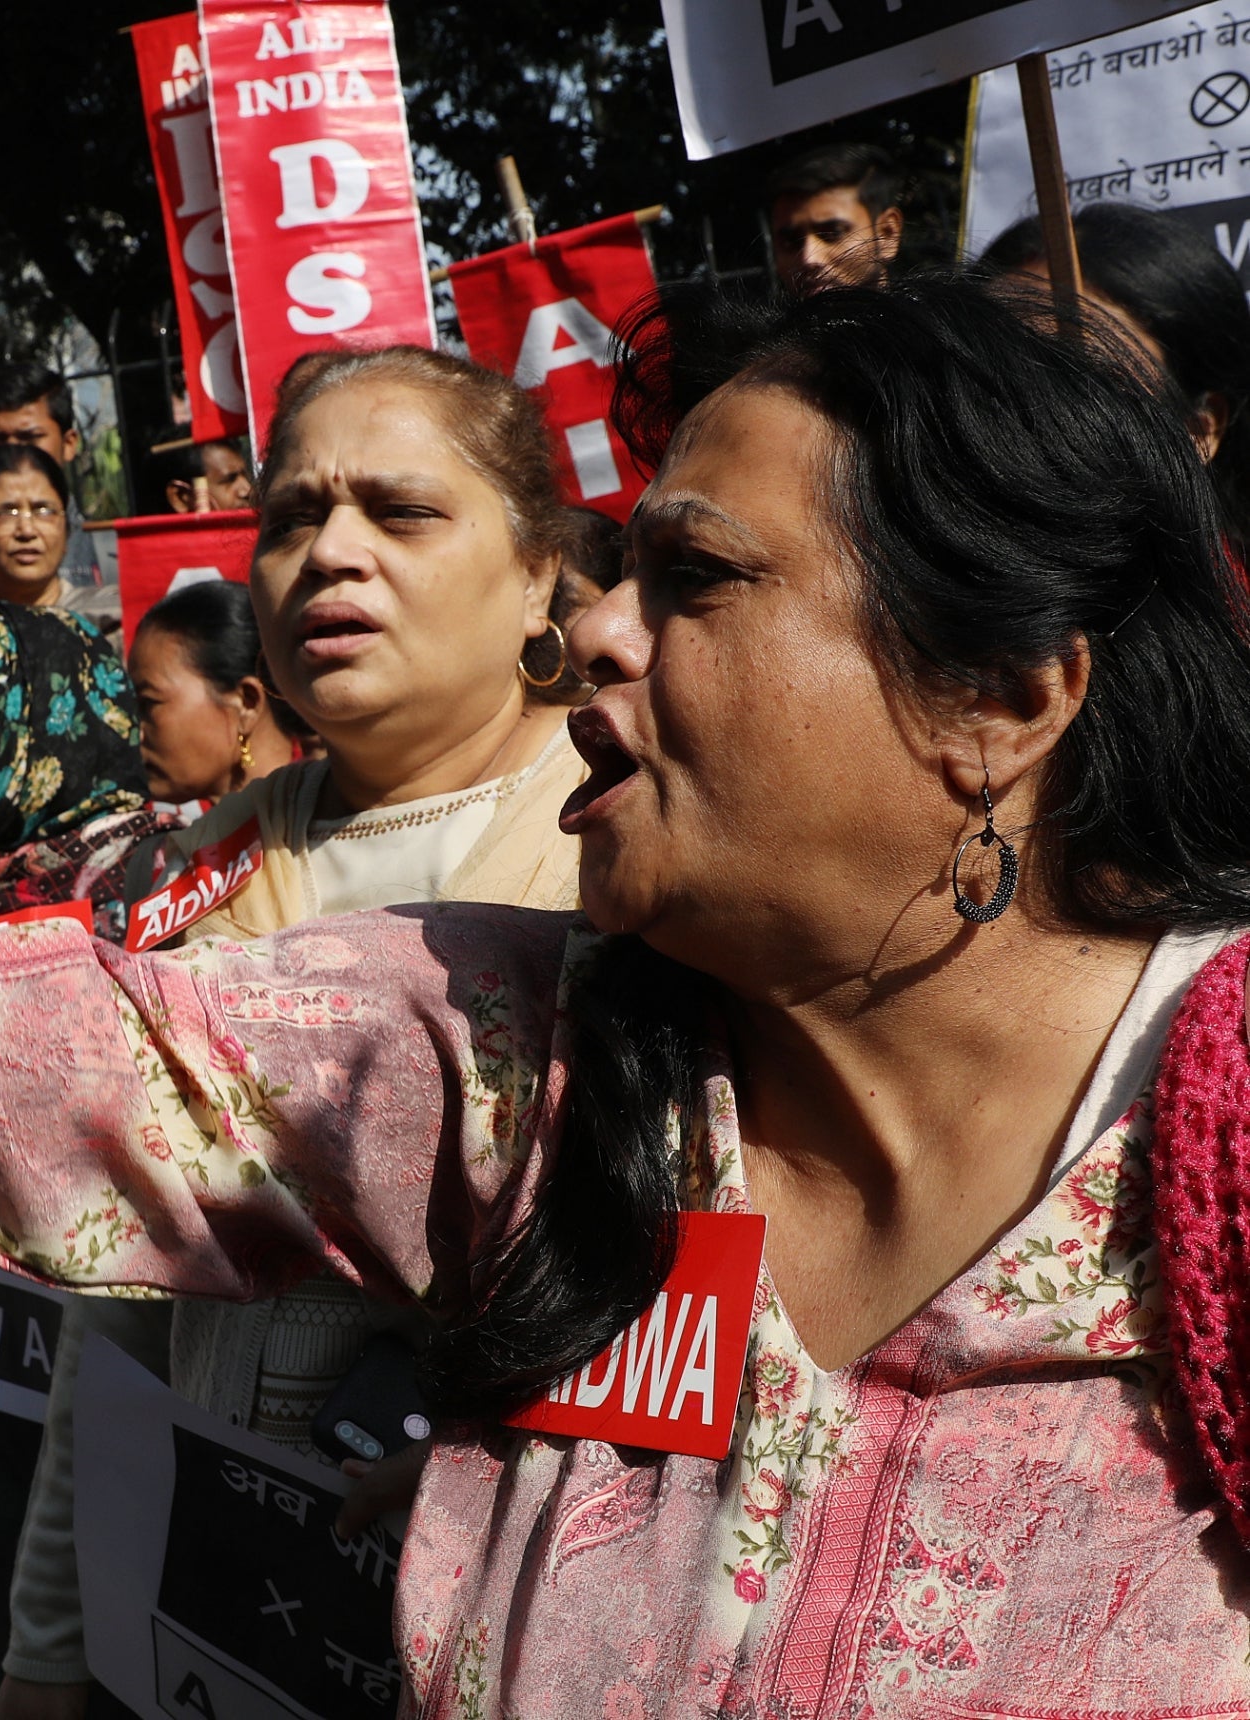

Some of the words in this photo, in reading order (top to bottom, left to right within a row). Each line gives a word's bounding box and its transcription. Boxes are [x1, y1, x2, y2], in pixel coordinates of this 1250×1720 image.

[256, 19, 344, 60] ALL
[1103, 21, 1206, 75] बचाओ
[236, 68, 375, 117] INDIA
[1144, 139, 1229, 203] जुमले
[136, 850, 254, 948] AIDWA
[219, 1455, 317, 1528] अब
